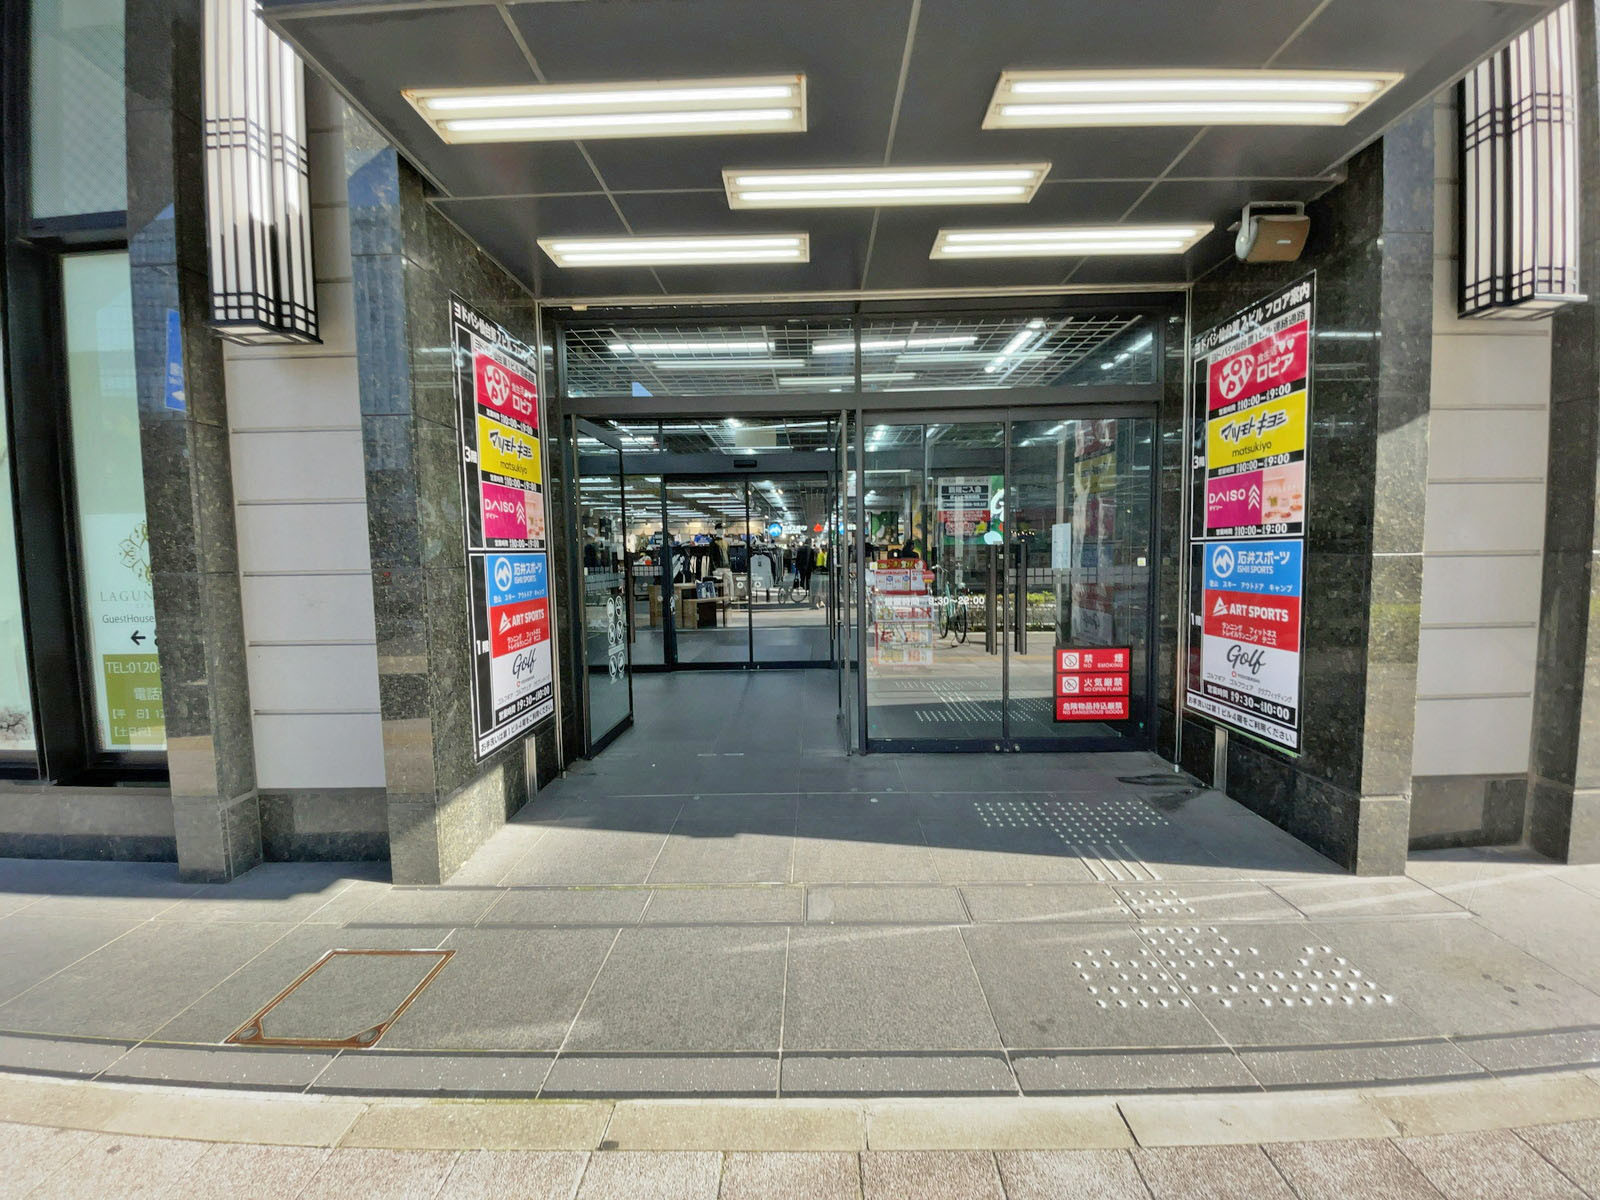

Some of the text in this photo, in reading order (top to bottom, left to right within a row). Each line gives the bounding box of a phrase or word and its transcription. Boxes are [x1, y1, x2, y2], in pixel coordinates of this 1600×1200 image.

[1257, 352, 1294, 383] ロピア
[1221, 410, 1287, 442] マツモトキヨシ
[1232, 440, 1272, 457] matsukiyo
[484, 498, 515, 513] DAISO
[1209, 489, 1246, 504] DAISO
[1237, 550, 1290, 565] 石井スポーツ
[1269, 584, 1293, 592] キャンプ
[102, 614, 155, 623] GuestHouse
[512, 608, 545, 627] ART SPORTS
[1229, 603, 1289, 622] ART SPORTS
[512, 648, 537, 679] Golf
[1226, 644, 1266, 675] Golf
